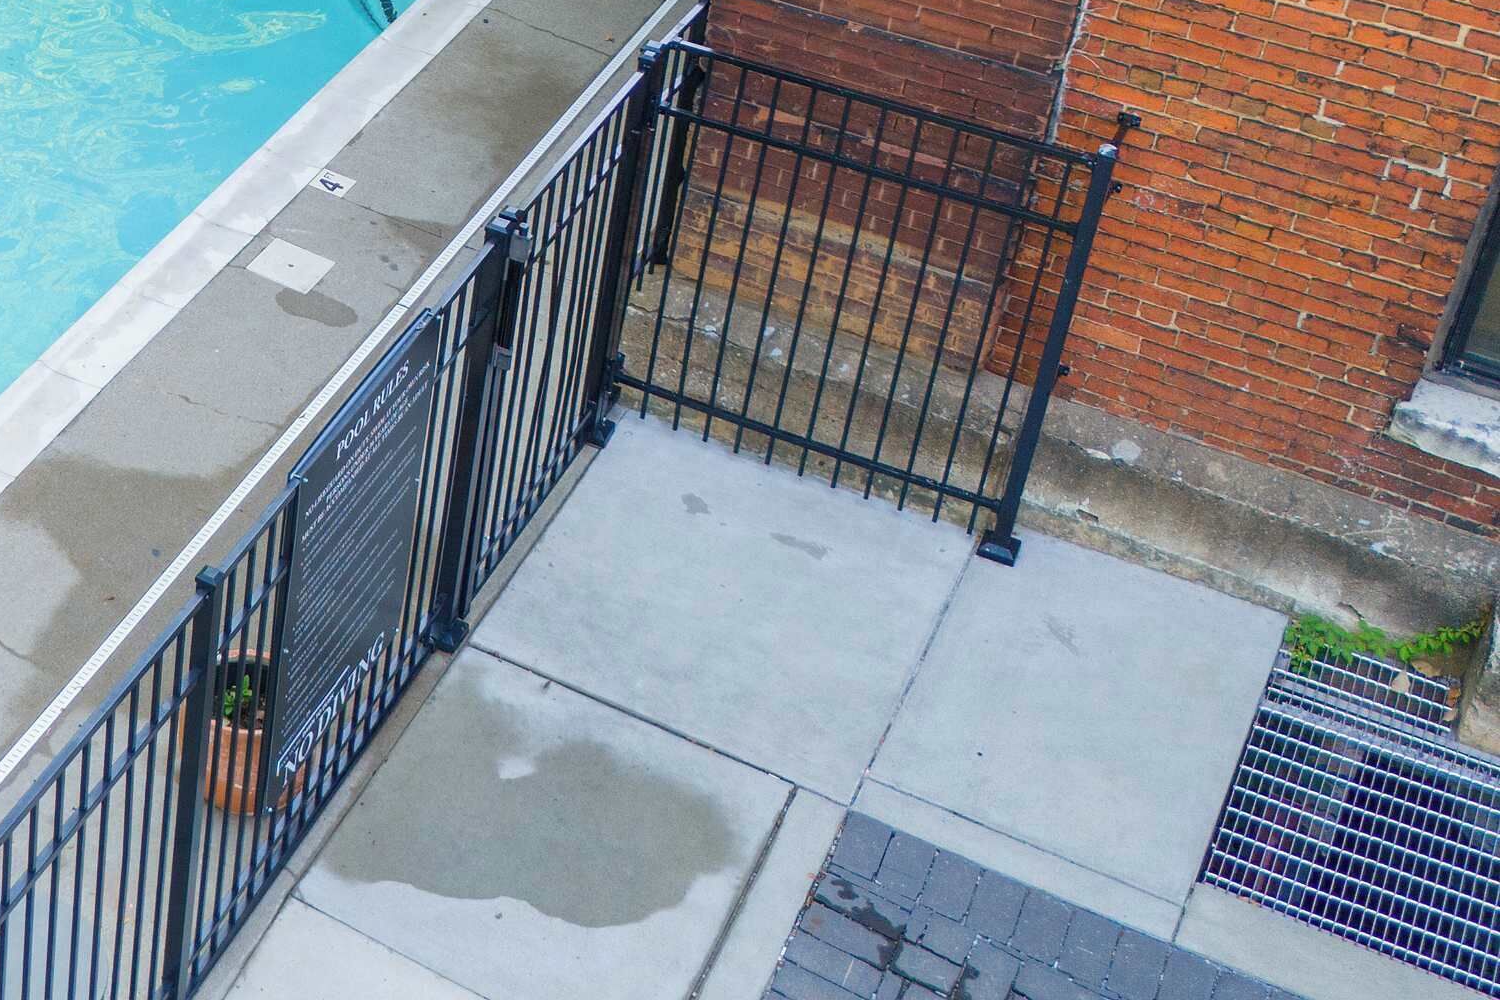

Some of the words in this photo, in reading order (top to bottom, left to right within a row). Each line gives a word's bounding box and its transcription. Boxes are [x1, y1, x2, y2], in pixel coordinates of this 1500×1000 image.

[319, 178, 344, 192] 4
[336, 409, 371, 461] POOL
[372, 360, 410, 416] RULES
[283, 731, 314, 787] NO
[316, 632, 385, 740] DIVING
